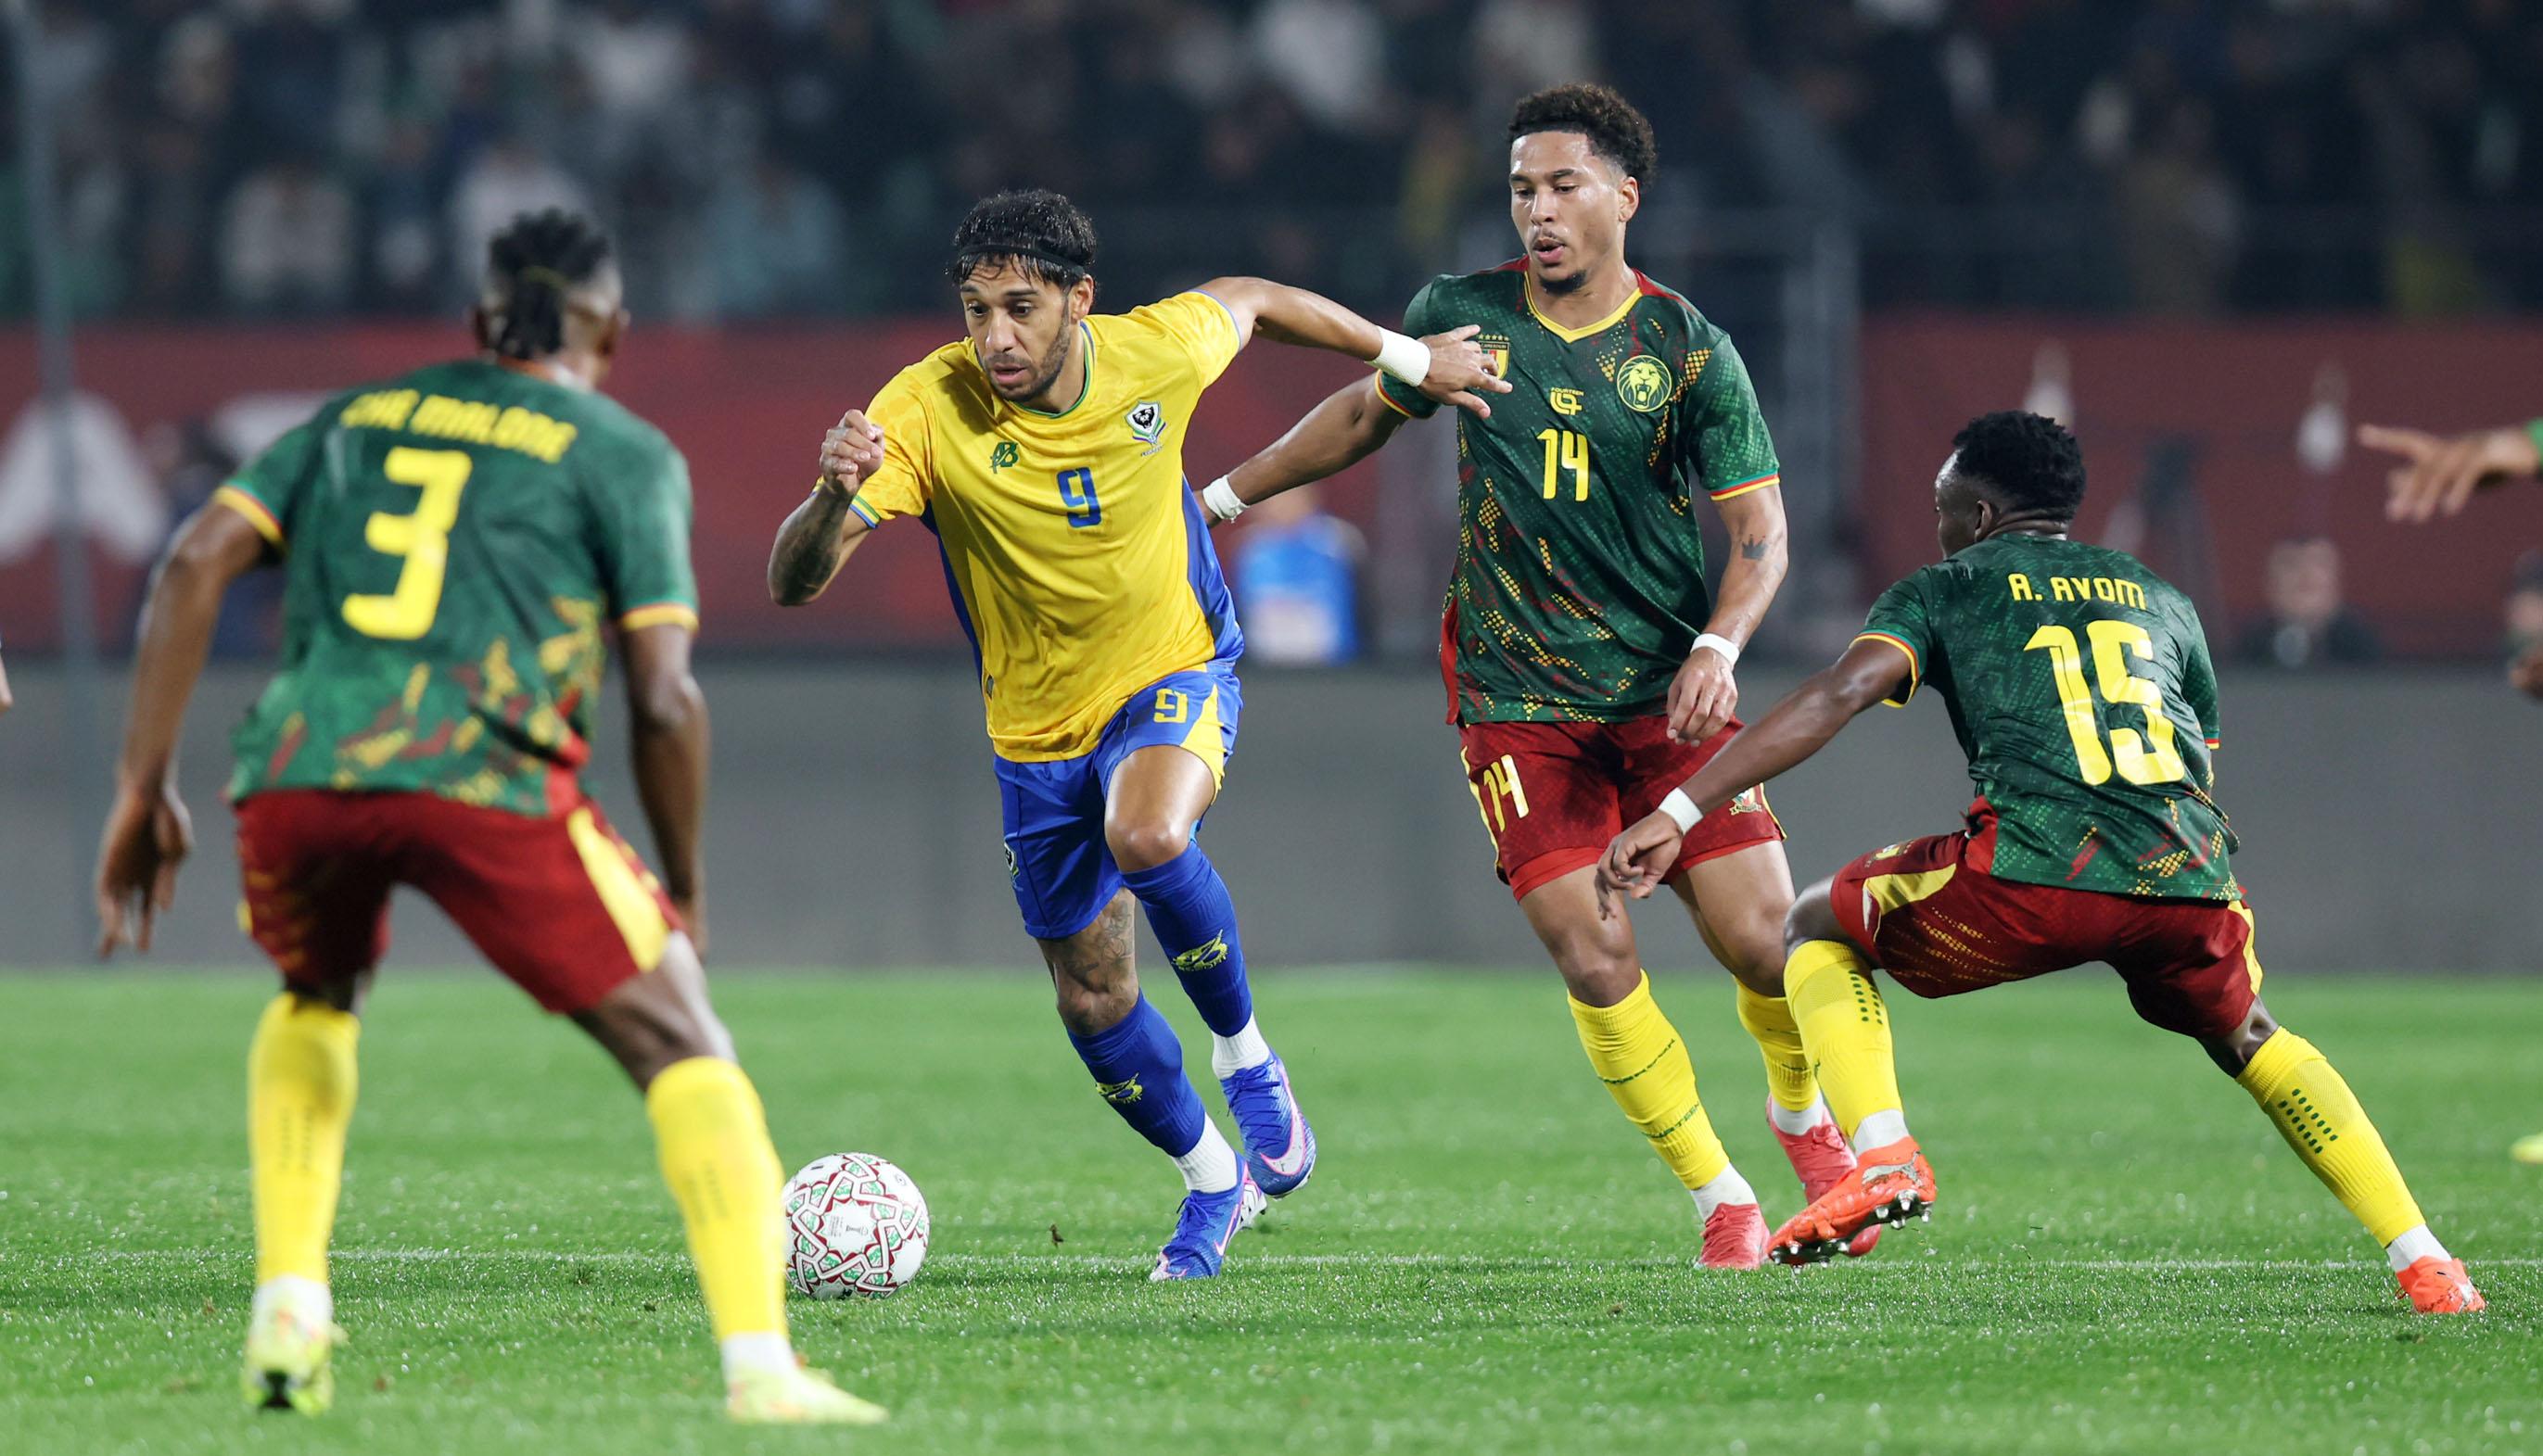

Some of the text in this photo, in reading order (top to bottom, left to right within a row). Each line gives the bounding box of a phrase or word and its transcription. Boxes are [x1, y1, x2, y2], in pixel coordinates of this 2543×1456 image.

[1057, 466, 1102, 529] 9
[1536, 428, 1589, 501] 14
[341, 447, 472, 639] 3
[2007, 573, 2146, 610] A. AVOM
[1153, 689, 1188, 723] 9
[2023, 619, 2185, 786] 15
[1483, 754, 1530, 832] 14
